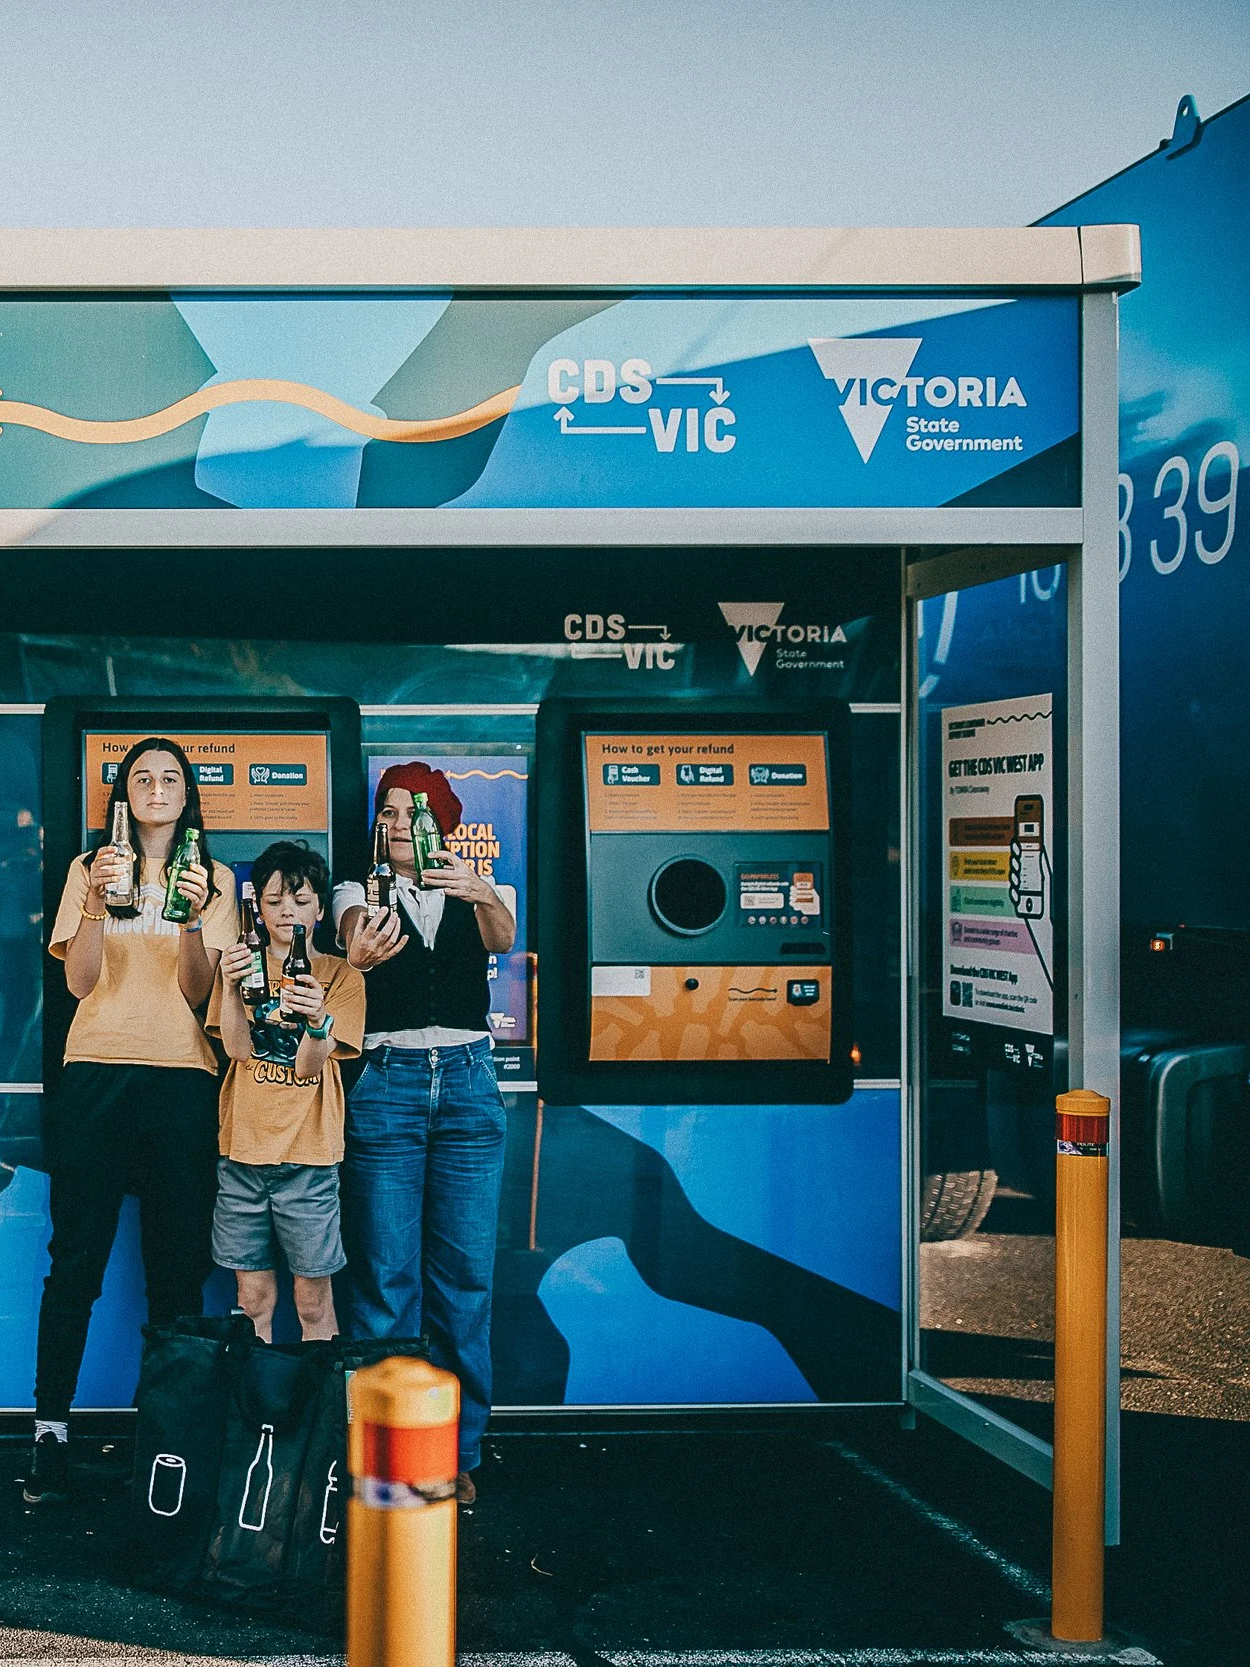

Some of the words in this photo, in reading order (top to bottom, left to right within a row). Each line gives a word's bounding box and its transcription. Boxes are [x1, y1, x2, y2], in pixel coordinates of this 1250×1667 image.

[548, 358, 653, 405] CDS
[837, 376, 1027, 407] VICTORIA
[648, 407, 737, 453] VIC
[906, 416, 959, 434] State
[906, 434, 1024, 452] Government
[564, 614, 626, 640] CDS
[733, 625, 847, 643] VICTORIA
[623, 643, 675, 670] VIC
[776, 649, 807, 659] State
[776, 659, 844, 669] Government
[102, 743, 128, 752] How
[198, 743, 235, 753] refund
[602, 744, 628, 754] How
[632, 745, 643, 754] to
[647, 745, 665, 756] get
[668, 746, 694, 756] your
[697, 744, 734, 754] refund
[199, 766, 223, 774] Digital
[622, 766, 639, 774] Cash
[699, 766, 722, 775] Digital
[949, 760, 961, 778] GET
[961, 759, 977, 776] THE
[978, 758, 993, 775] CDS
[1006, 754, 1027, 773] WEST
[1028, 753, 1044, 771] APP
[271, 772, 304, 780] Donation
[477, 859, 493, 876] IS
